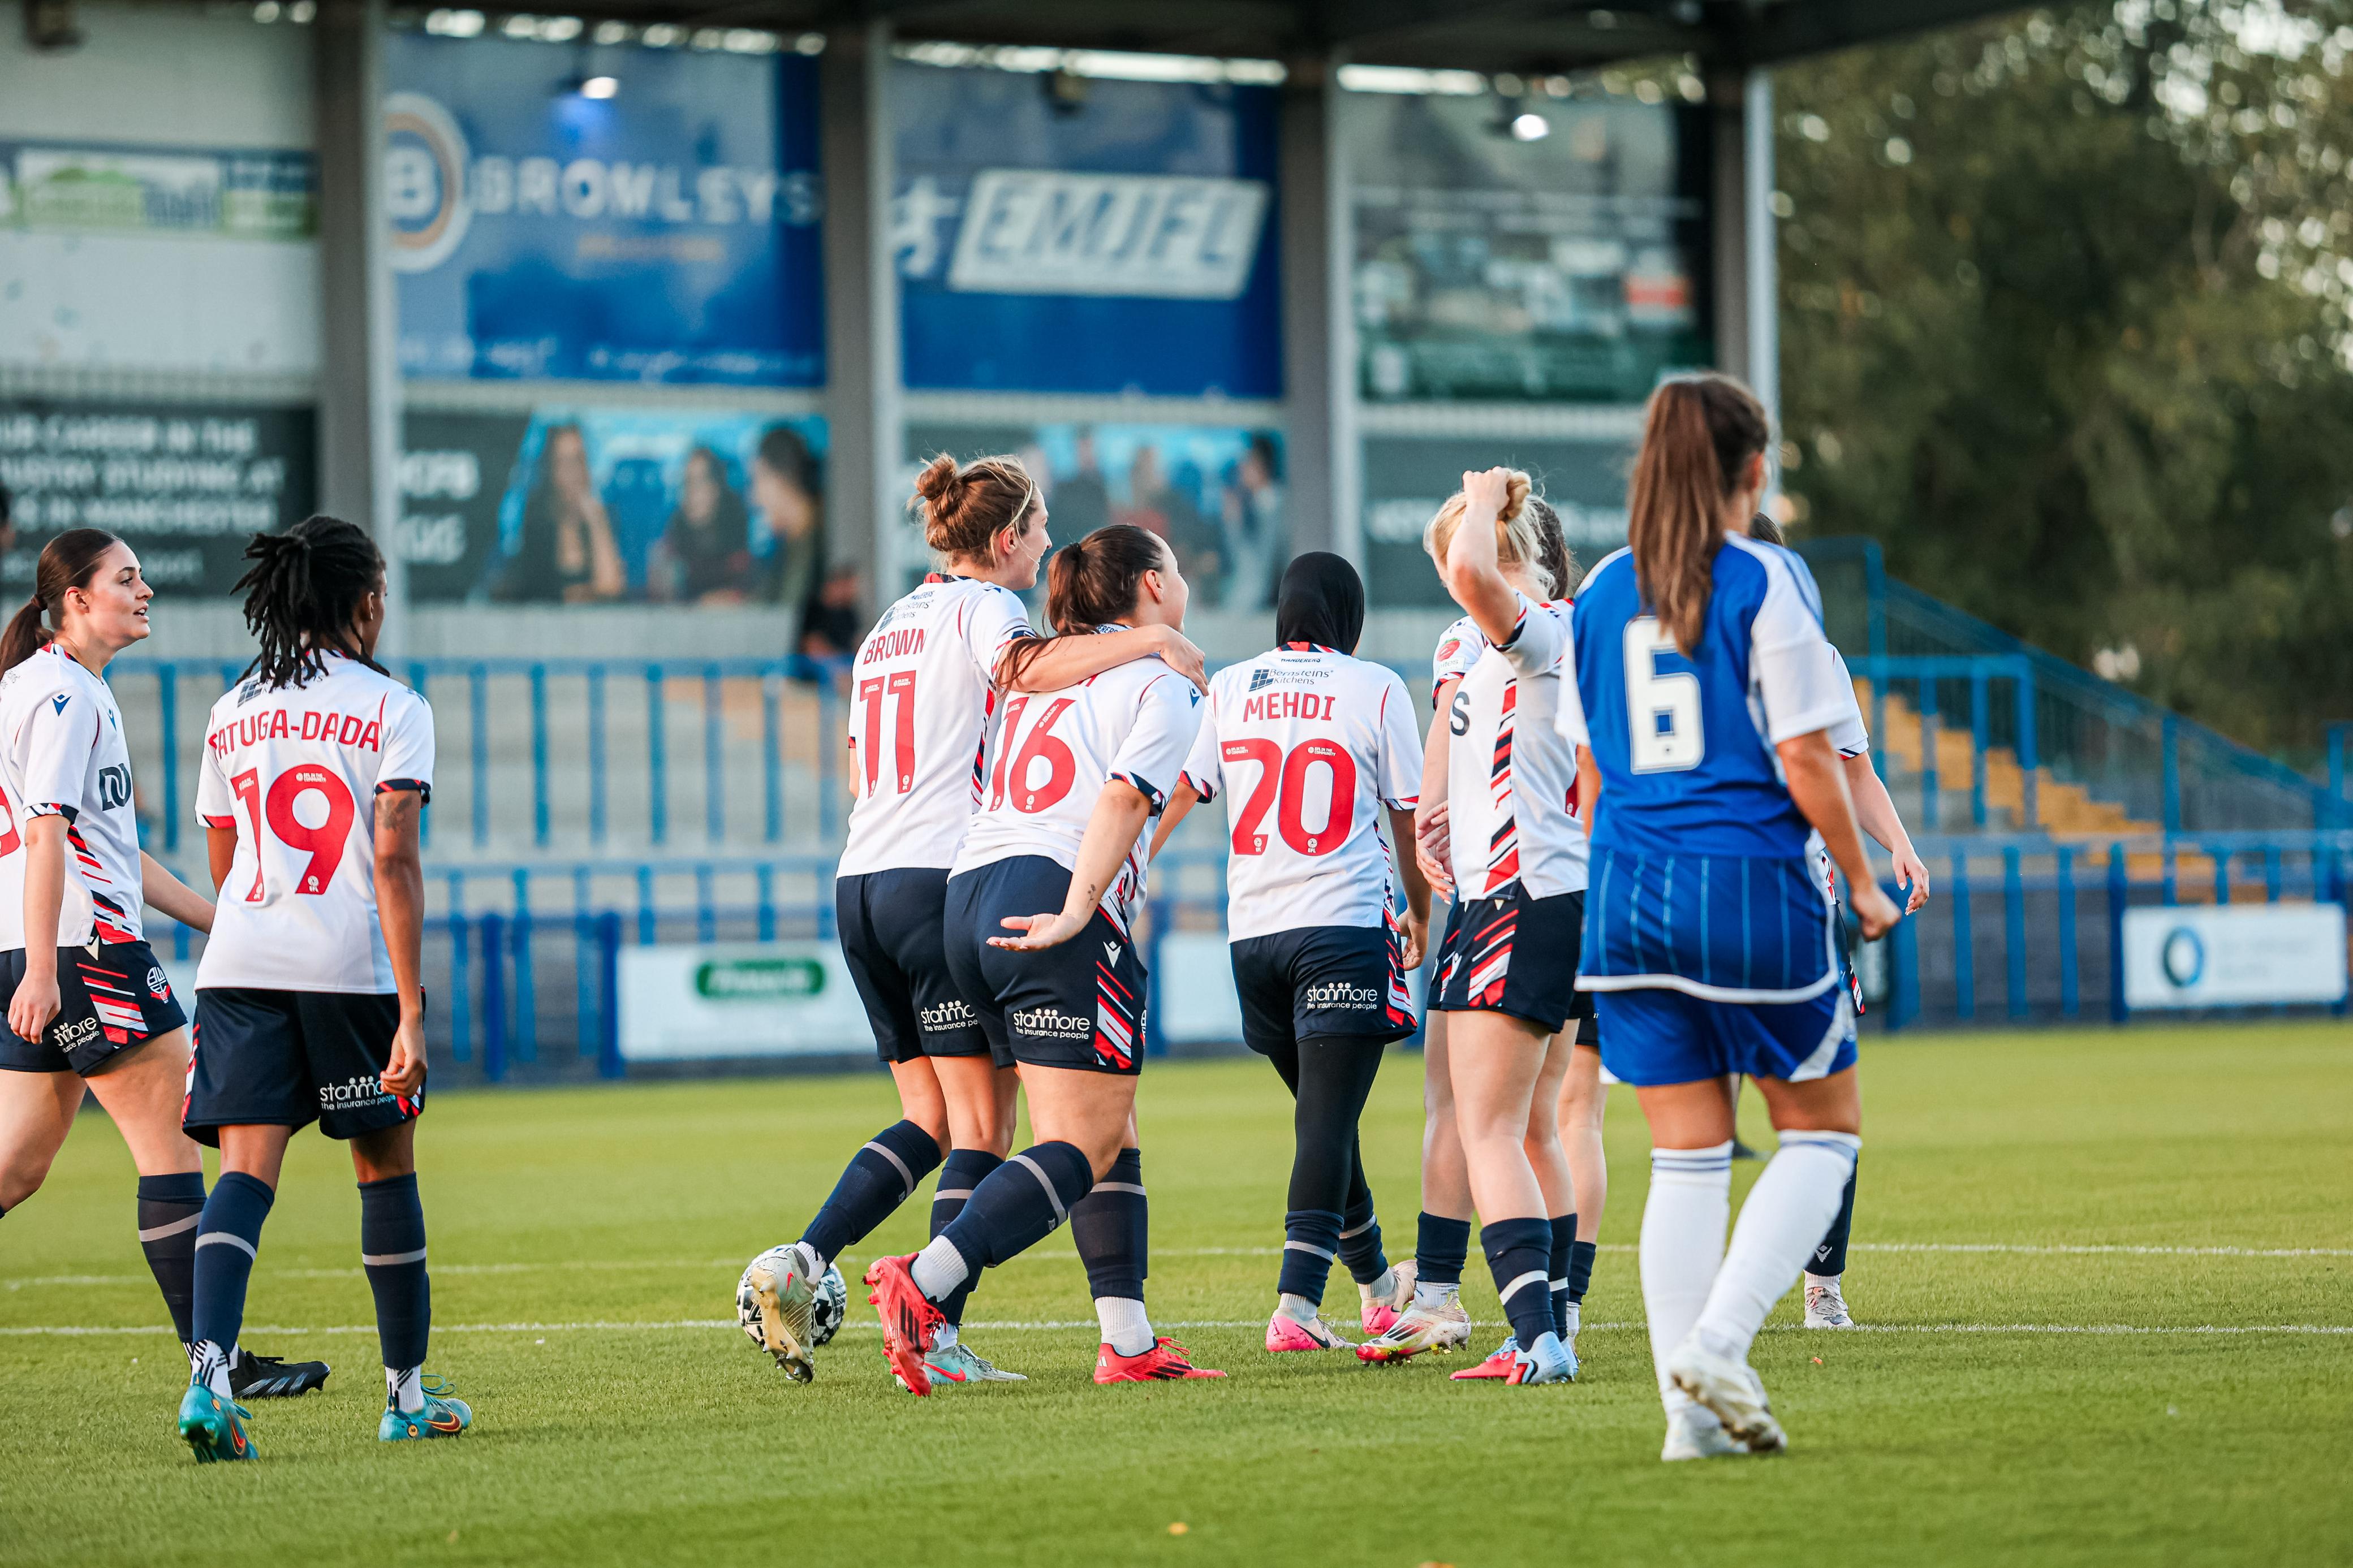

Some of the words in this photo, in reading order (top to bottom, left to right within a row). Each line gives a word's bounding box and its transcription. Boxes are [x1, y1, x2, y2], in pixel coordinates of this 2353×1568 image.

[863, 628, 929, 665] BROWN
[1269, 669, 1330, 678] Bernsteins
[1273, 676, 1315, 685] Kitchens
[1622, 615, 1705, 775] 6
[1243, 692, 1336, 723] MEHDI
[860, 669, 916, 799] 11
[988, 696, 1076, 814] 16
[1220, 737, 1356, 857] 20
[230, 763, 355, 902] 19
[1307, 983, 1378, 1002] stanmore
[920, 1000, 975, 1024] stanmo
[1013, 1008, 1091, 1031] stanmore
[933, 1021, 966, 1031] insurance
[1024, 1027, 1058, 1037] insurance
[1059, 1031, 1089, 1040] people
[76, 1030, 100, 1047] people
[320, 1075, 383, 1103] stanmo
[321, 1102, 335, 1111] the
[337, 1098, 376, 1110] insurance
